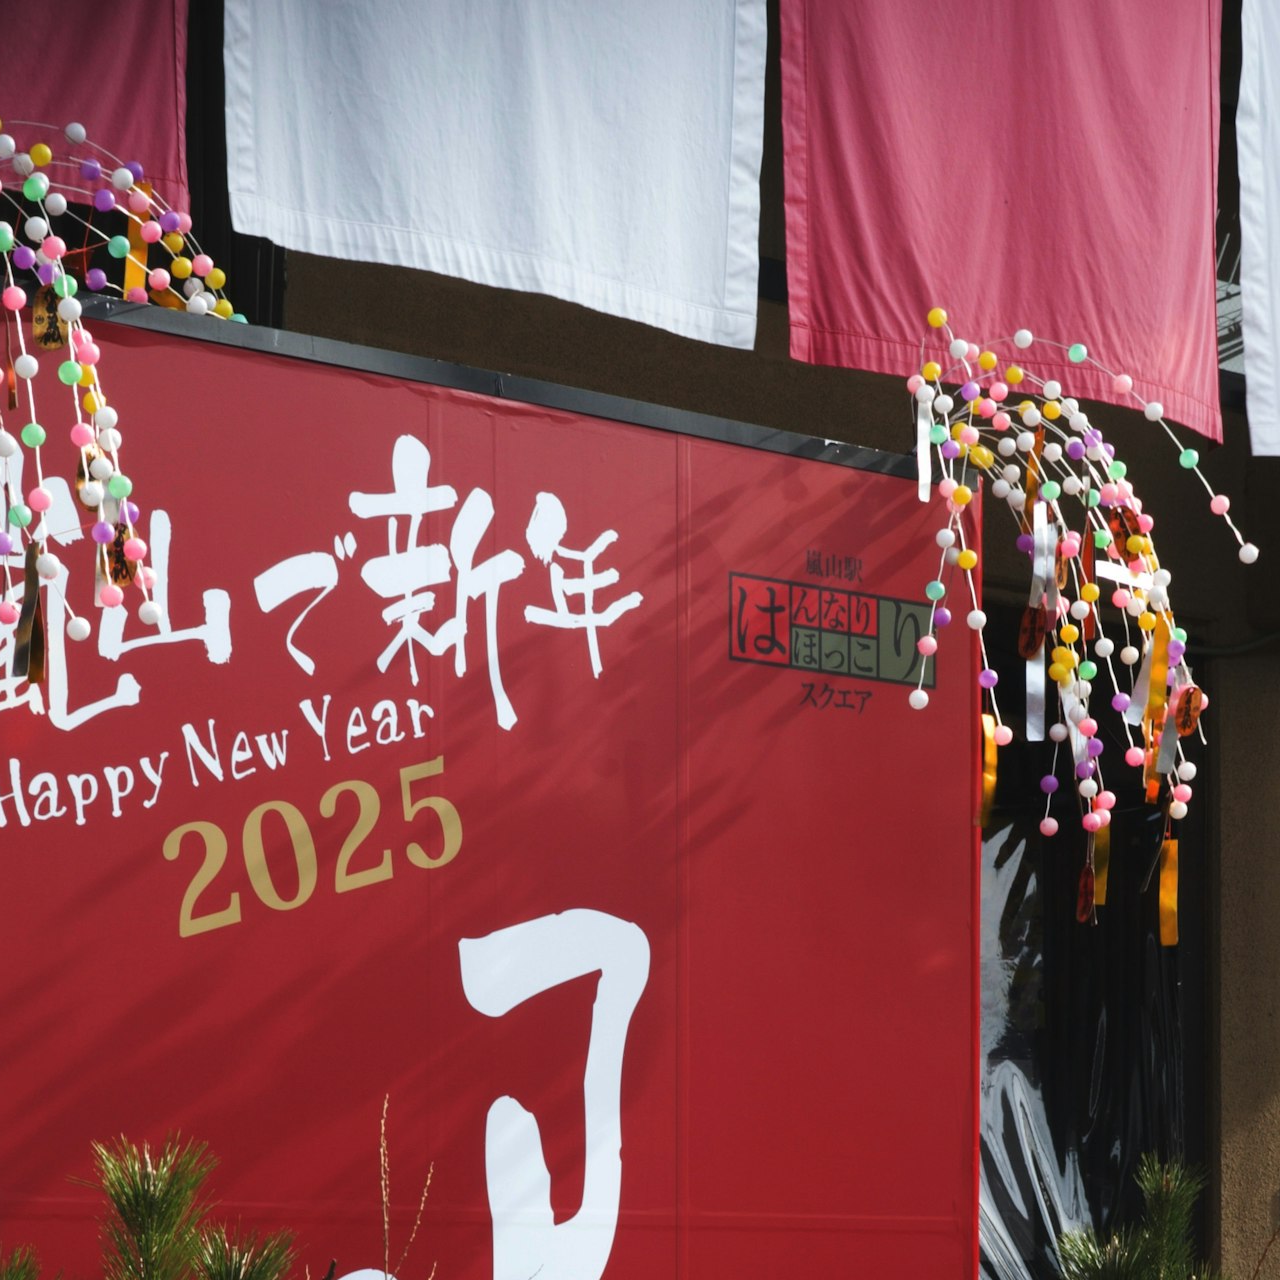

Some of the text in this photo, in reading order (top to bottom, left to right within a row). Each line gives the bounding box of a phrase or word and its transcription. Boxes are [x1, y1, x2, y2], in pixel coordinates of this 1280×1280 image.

[806, 550, 864, 583] 嵐山駅
[800, 682, 873, 714] スクエア
[182, 718, 289, 788] New
[299, 692, 435, 762] Year
[162, 755, 464, 939] 2025
